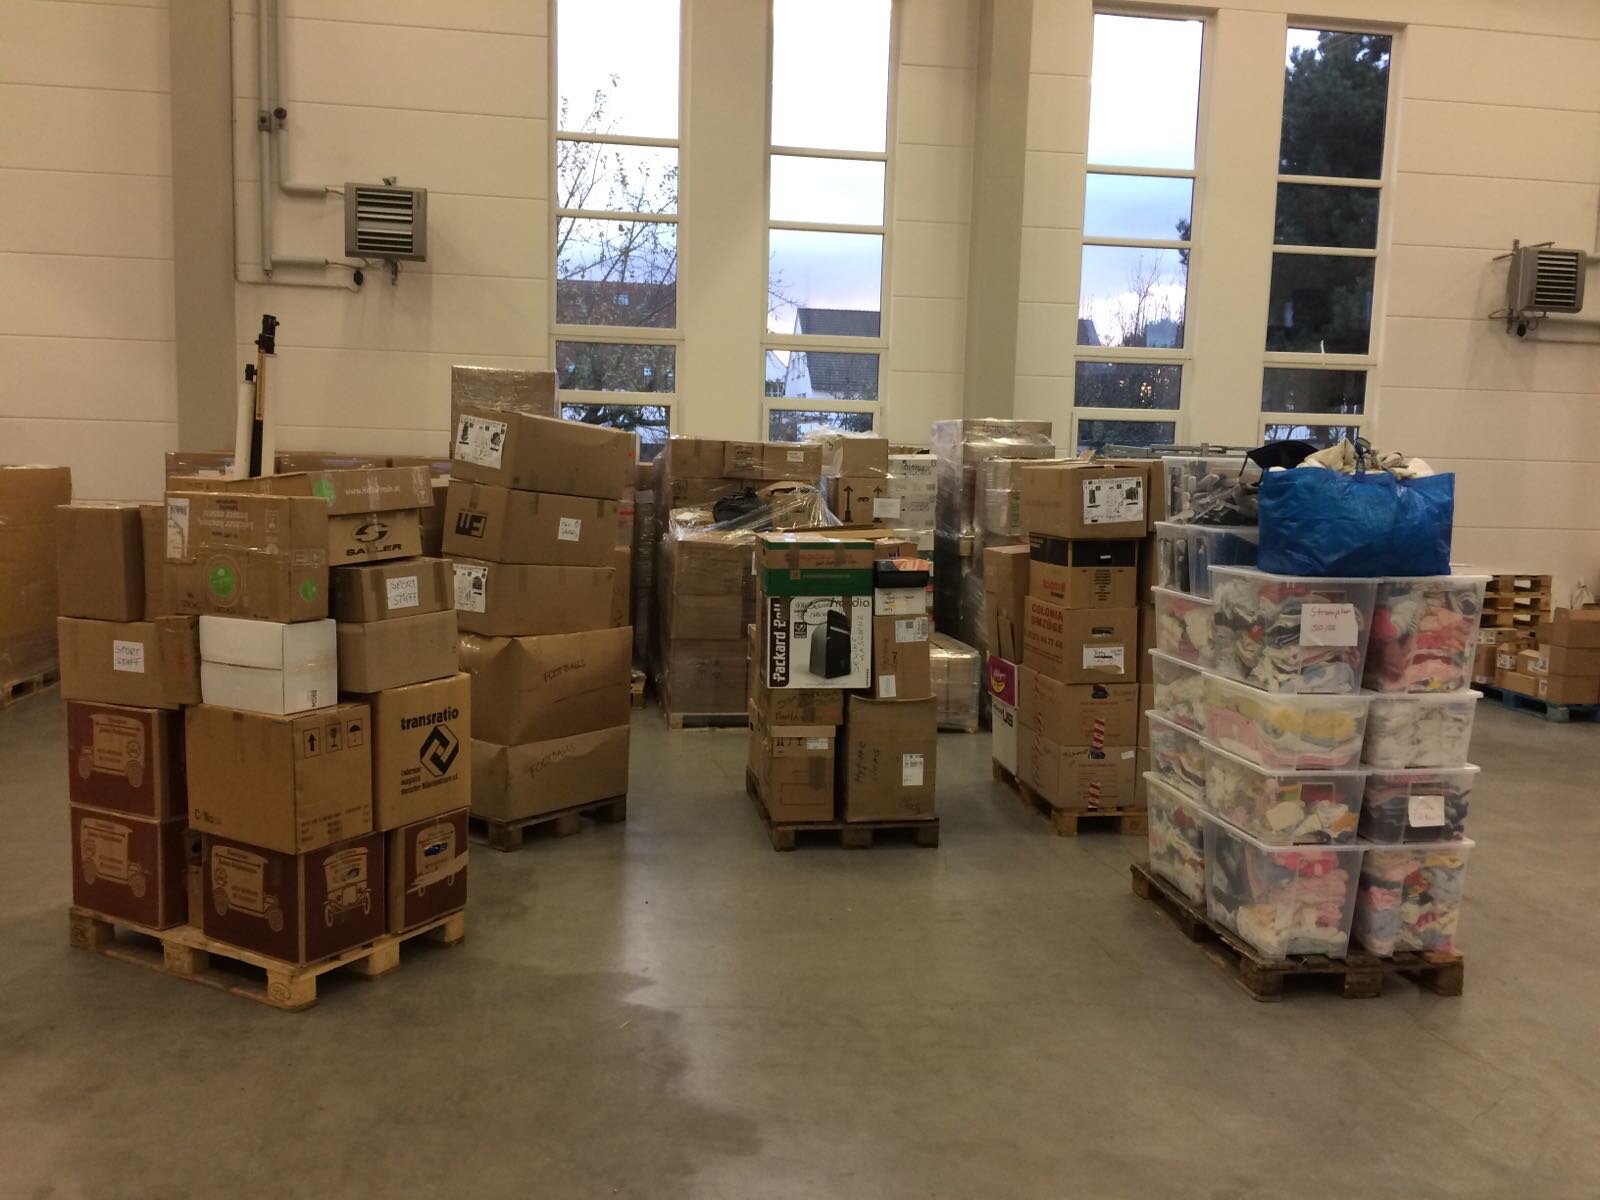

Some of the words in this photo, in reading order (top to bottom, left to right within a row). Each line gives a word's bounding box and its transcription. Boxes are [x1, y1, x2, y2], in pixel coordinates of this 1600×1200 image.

[345, 543, 402, 556] SALER
[772, 632, 787, 682] Packard
[400, 706, 460, 731] transratio
